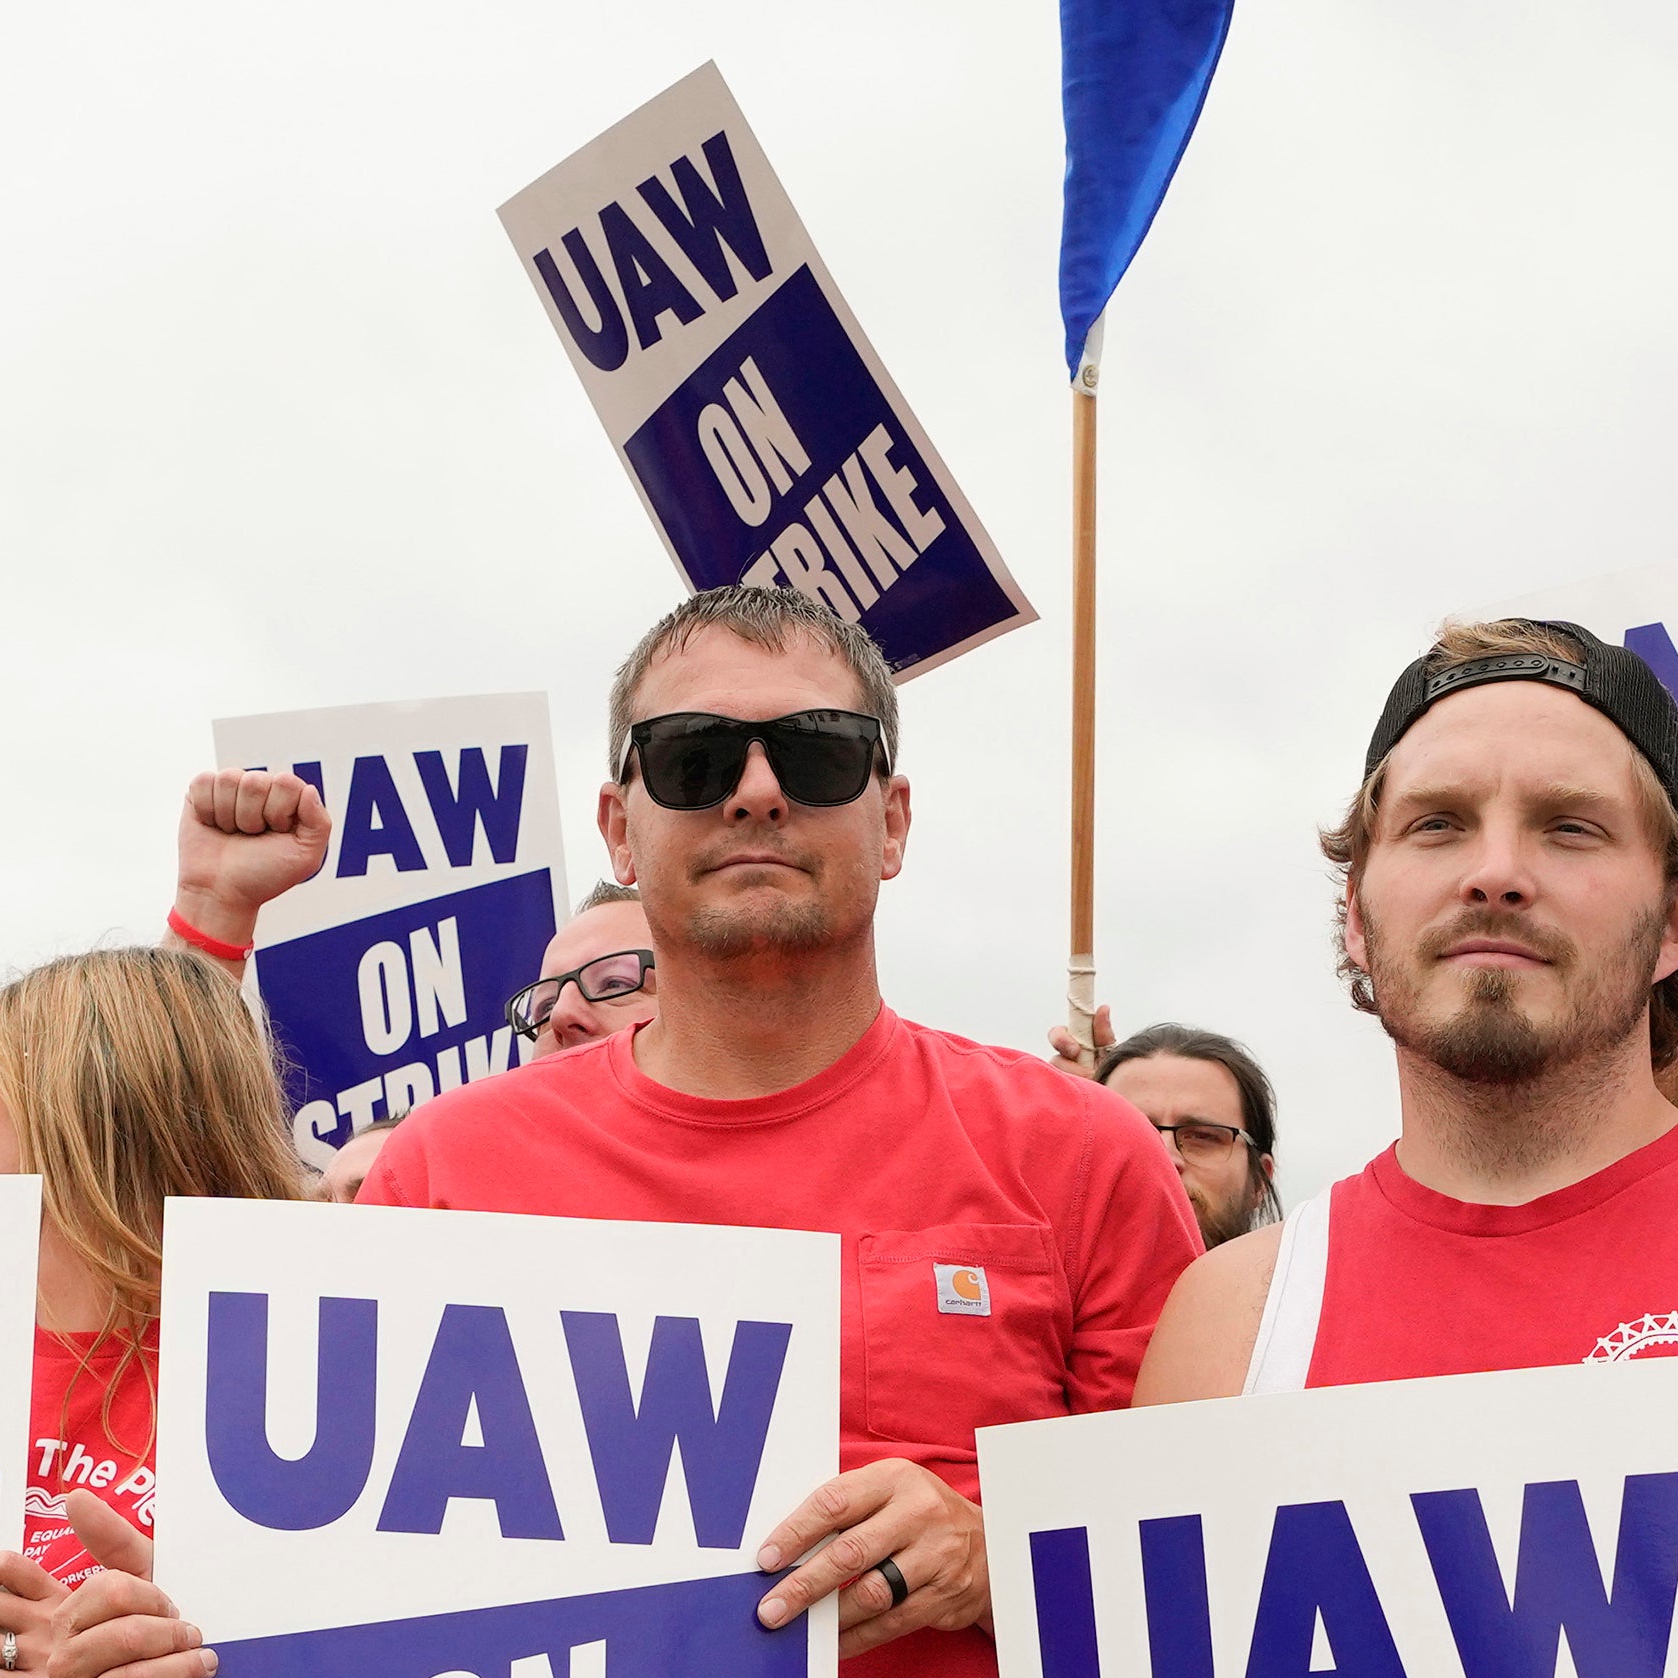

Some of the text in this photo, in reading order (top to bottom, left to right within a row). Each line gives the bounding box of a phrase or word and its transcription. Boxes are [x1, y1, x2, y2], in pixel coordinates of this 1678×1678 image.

[532, 129, 774, 373] UAW
[698, 355, 813, 528] ON
[741, 422, 947, 626] RIKE
[357, 915, 468, 1057] ON
[34, 1437, 118, 1488] The
[205, 1290, 794, 1551] UAW
[24, 1542, 52, 1558] PAY
[61, 1564, 106, 1586] ORKER
